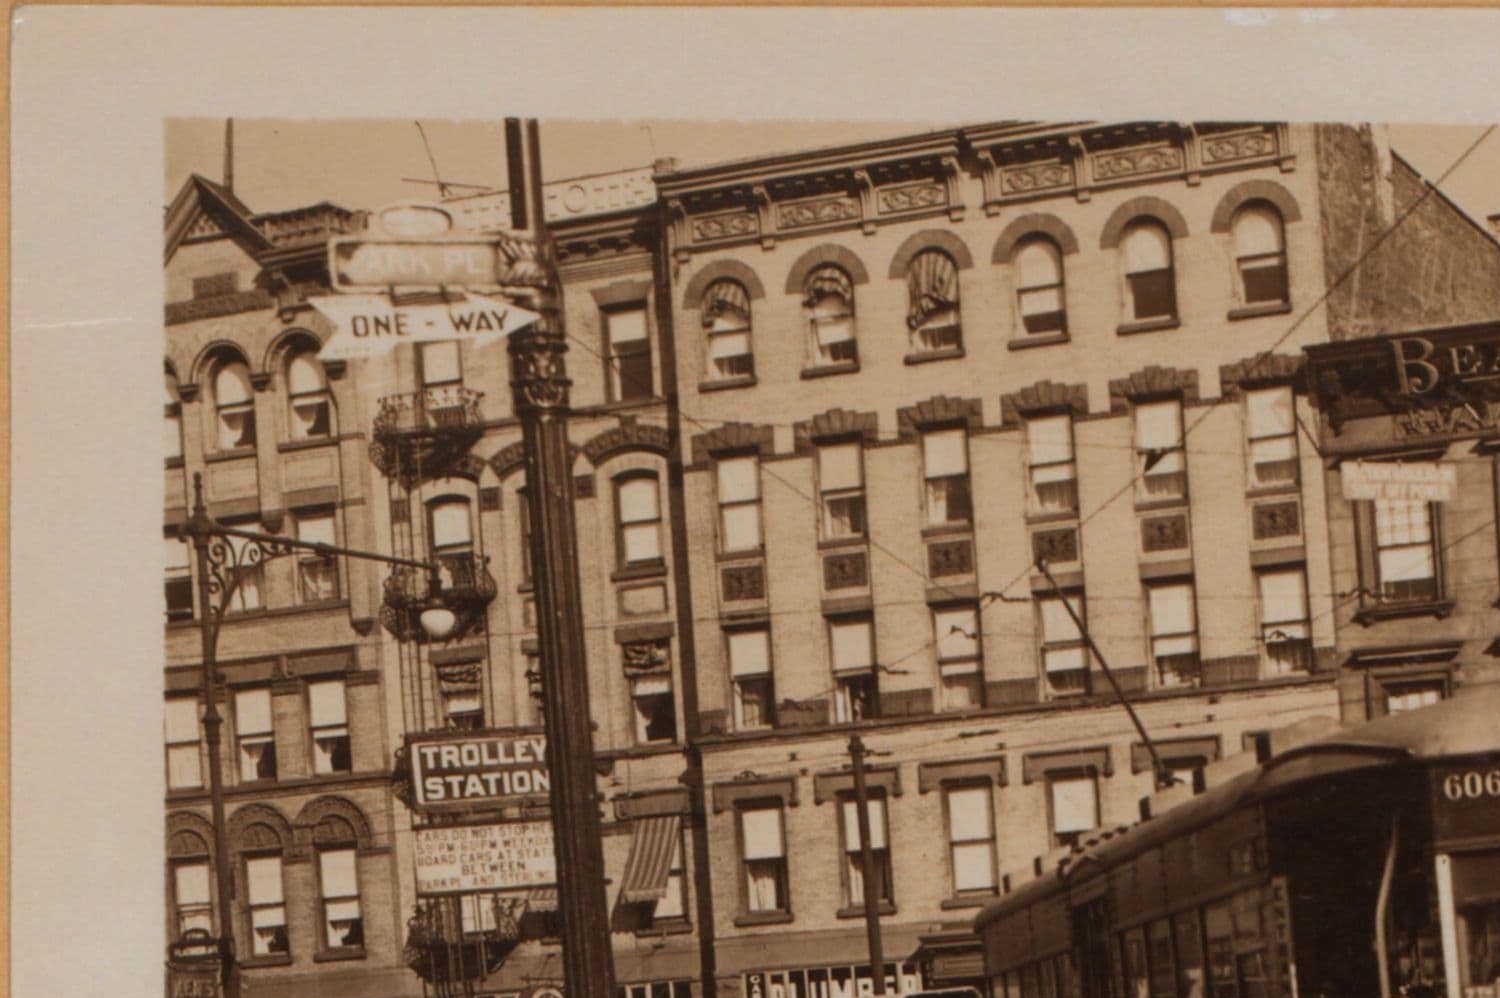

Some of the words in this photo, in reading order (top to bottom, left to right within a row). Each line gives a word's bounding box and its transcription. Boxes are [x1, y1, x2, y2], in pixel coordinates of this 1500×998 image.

[346, 247, 431, 276] ARK
[352, 312, 410, 337] ONE
[449, 309, 509, 332] WAY
[1396, 400, 1498, 437] REAL
[420, 739, 548, 770] TROLLEY
[425, 769, 551, 801] STATION
[503, 837, 550, 850] WEEKDA
[517, 846, 549, 860] STAT
[462, 860, 527, 876] BETWEEN
